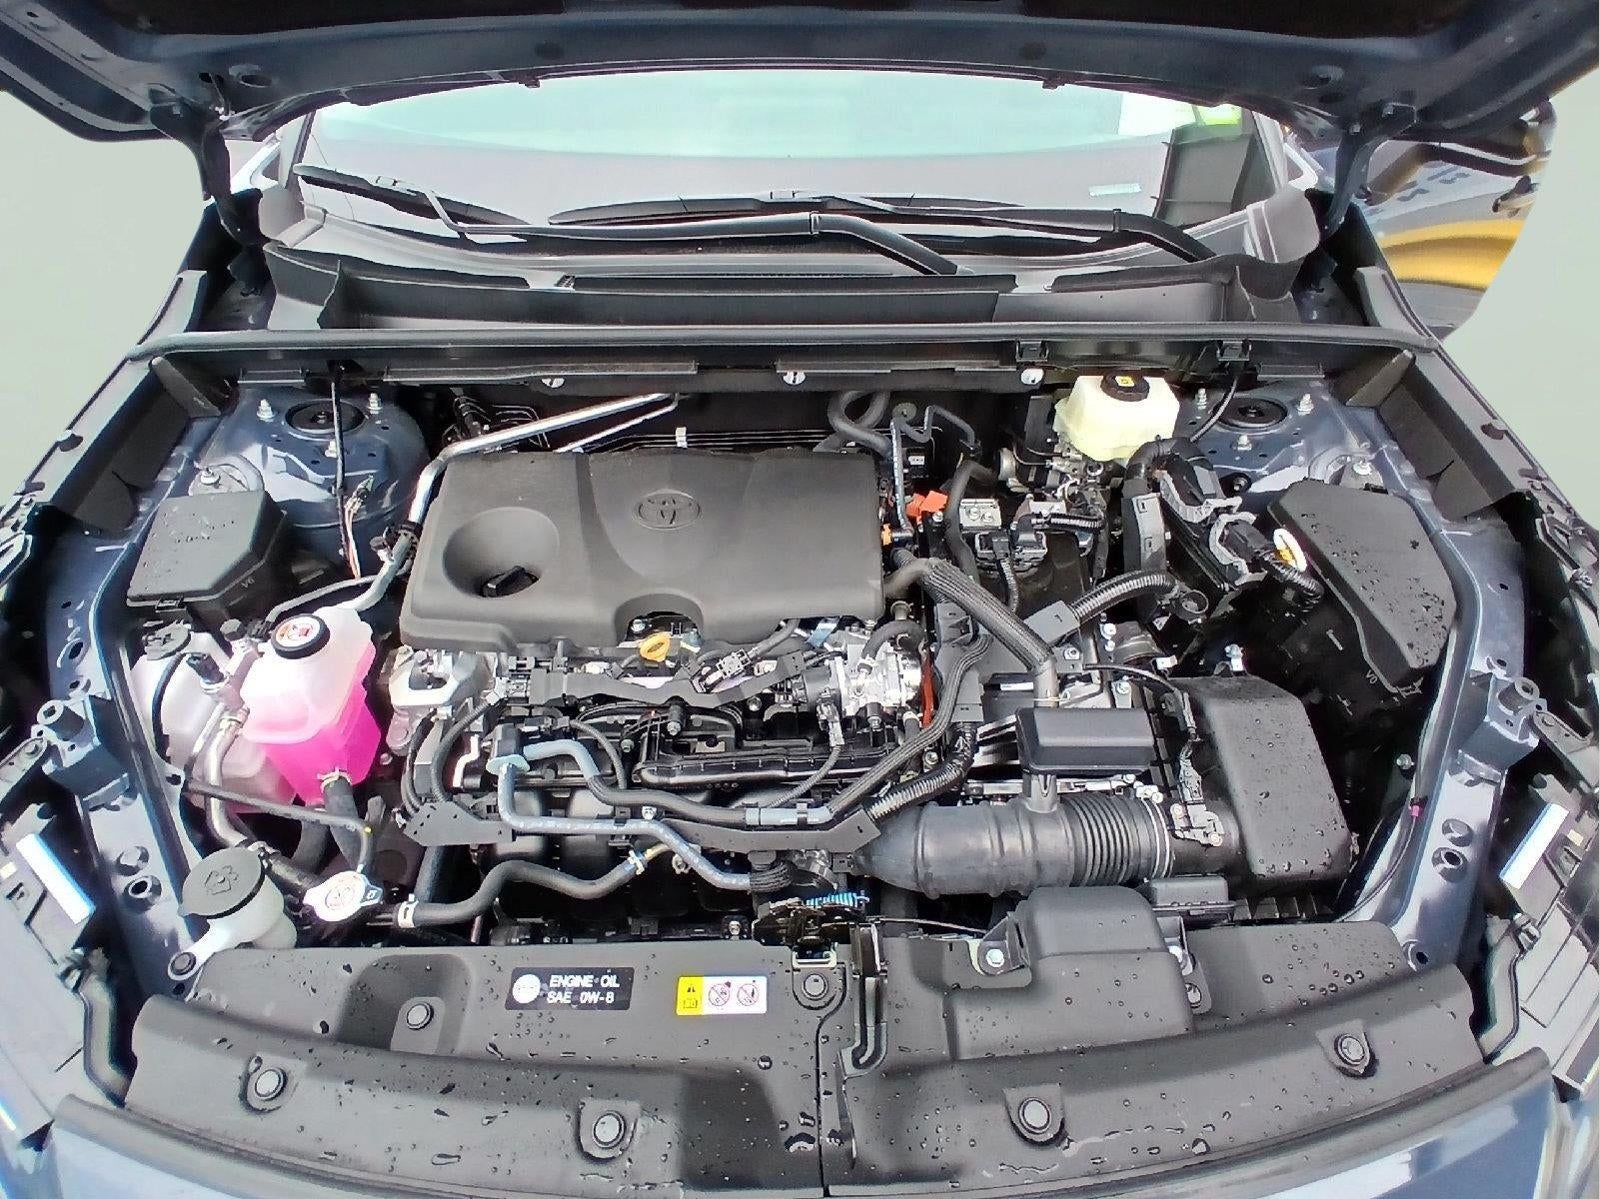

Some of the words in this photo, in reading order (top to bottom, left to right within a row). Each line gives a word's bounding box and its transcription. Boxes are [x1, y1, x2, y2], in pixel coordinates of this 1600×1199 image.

[549, 974, 595, 988] ENGINE
[600, 974, 620, 988] OIL
[547, 991, 572, 1004] SAE
[579, 991, 614, 1004] 0W-8
